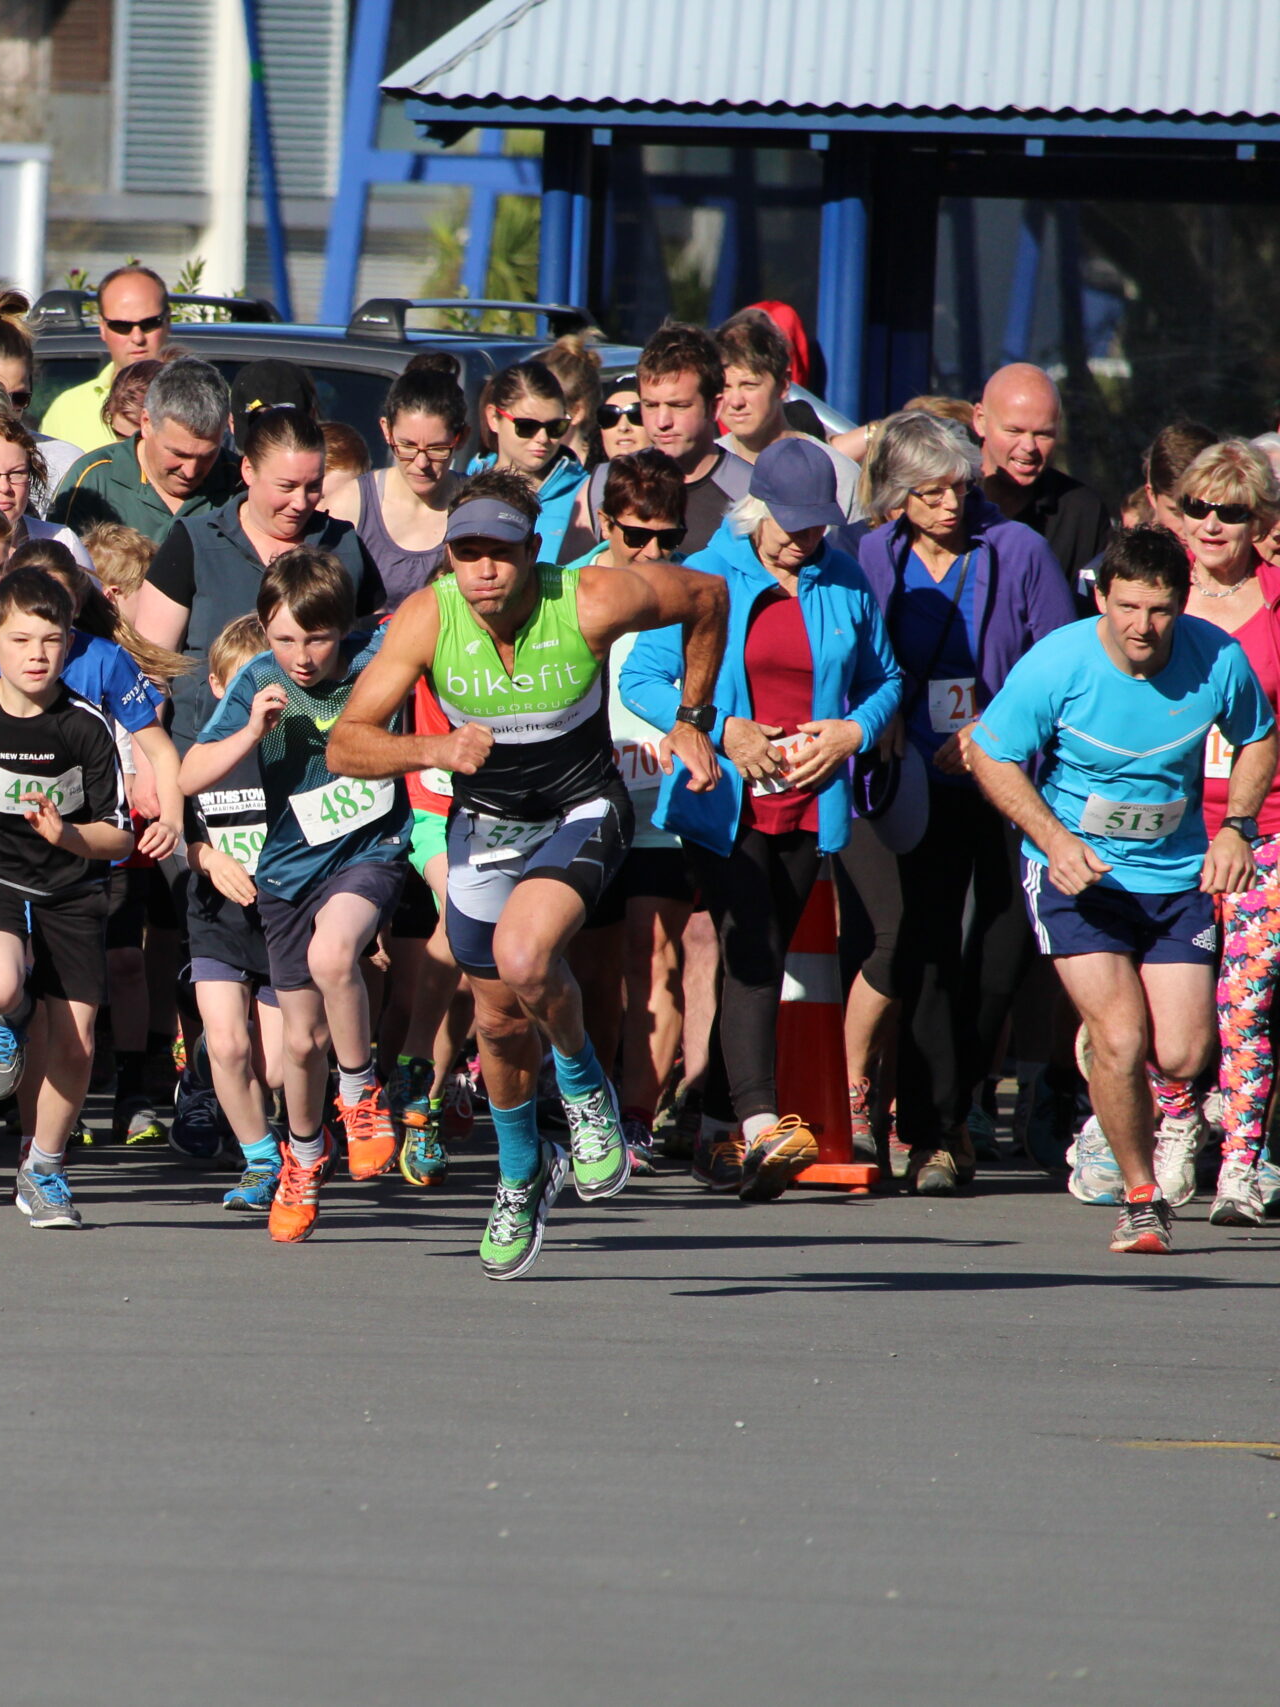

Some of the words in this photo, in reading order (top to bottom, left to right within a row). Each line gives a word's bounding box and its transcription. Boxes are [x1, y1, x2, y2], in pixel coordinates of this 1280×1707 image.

[446, 662, 581, 697] bikefit
[0, 752, 18, 760] NEW
[19, 753, 55, 761] ZEALAND
[4, 779, 64, 806] 406
[215, 790, 240, 804] THIS
[240, 788, 266, 802] TOW
[320, 779, 376, 825] 483
[212, 802, 266, 812] MARINA2MARI
[1105, 811, 1164, 832] 513
[486, 825, 546, 848] 527
[1191, 937, 1216, 952] adida
